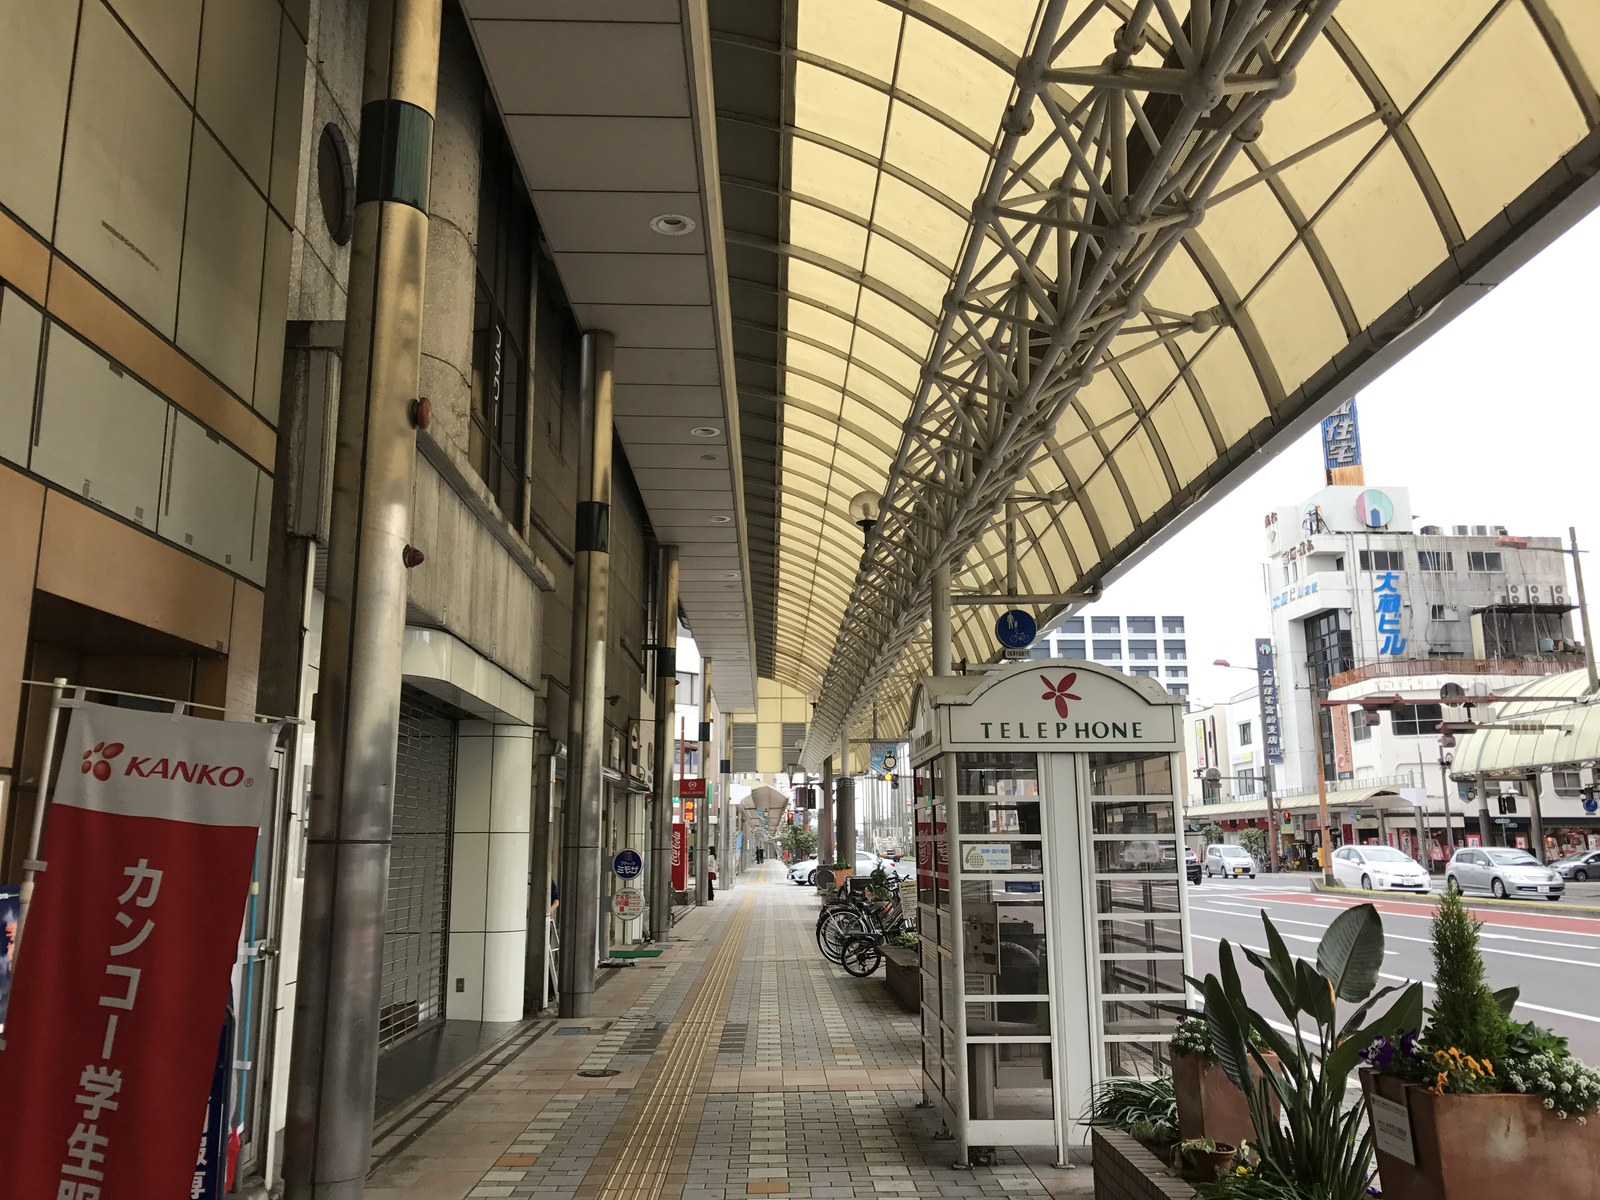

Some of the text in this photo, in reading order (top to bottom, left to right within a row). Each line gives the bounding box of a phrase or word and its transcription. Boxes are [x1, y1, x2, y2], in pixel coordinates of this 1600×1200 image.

[1373, 571, 1407, 656] 大蔵ビル
[980, 721, 1143, 739] TELEPHONE
[123, 756, 246, 788] KANKO
[616, 865, 640, 875] ミモザ
